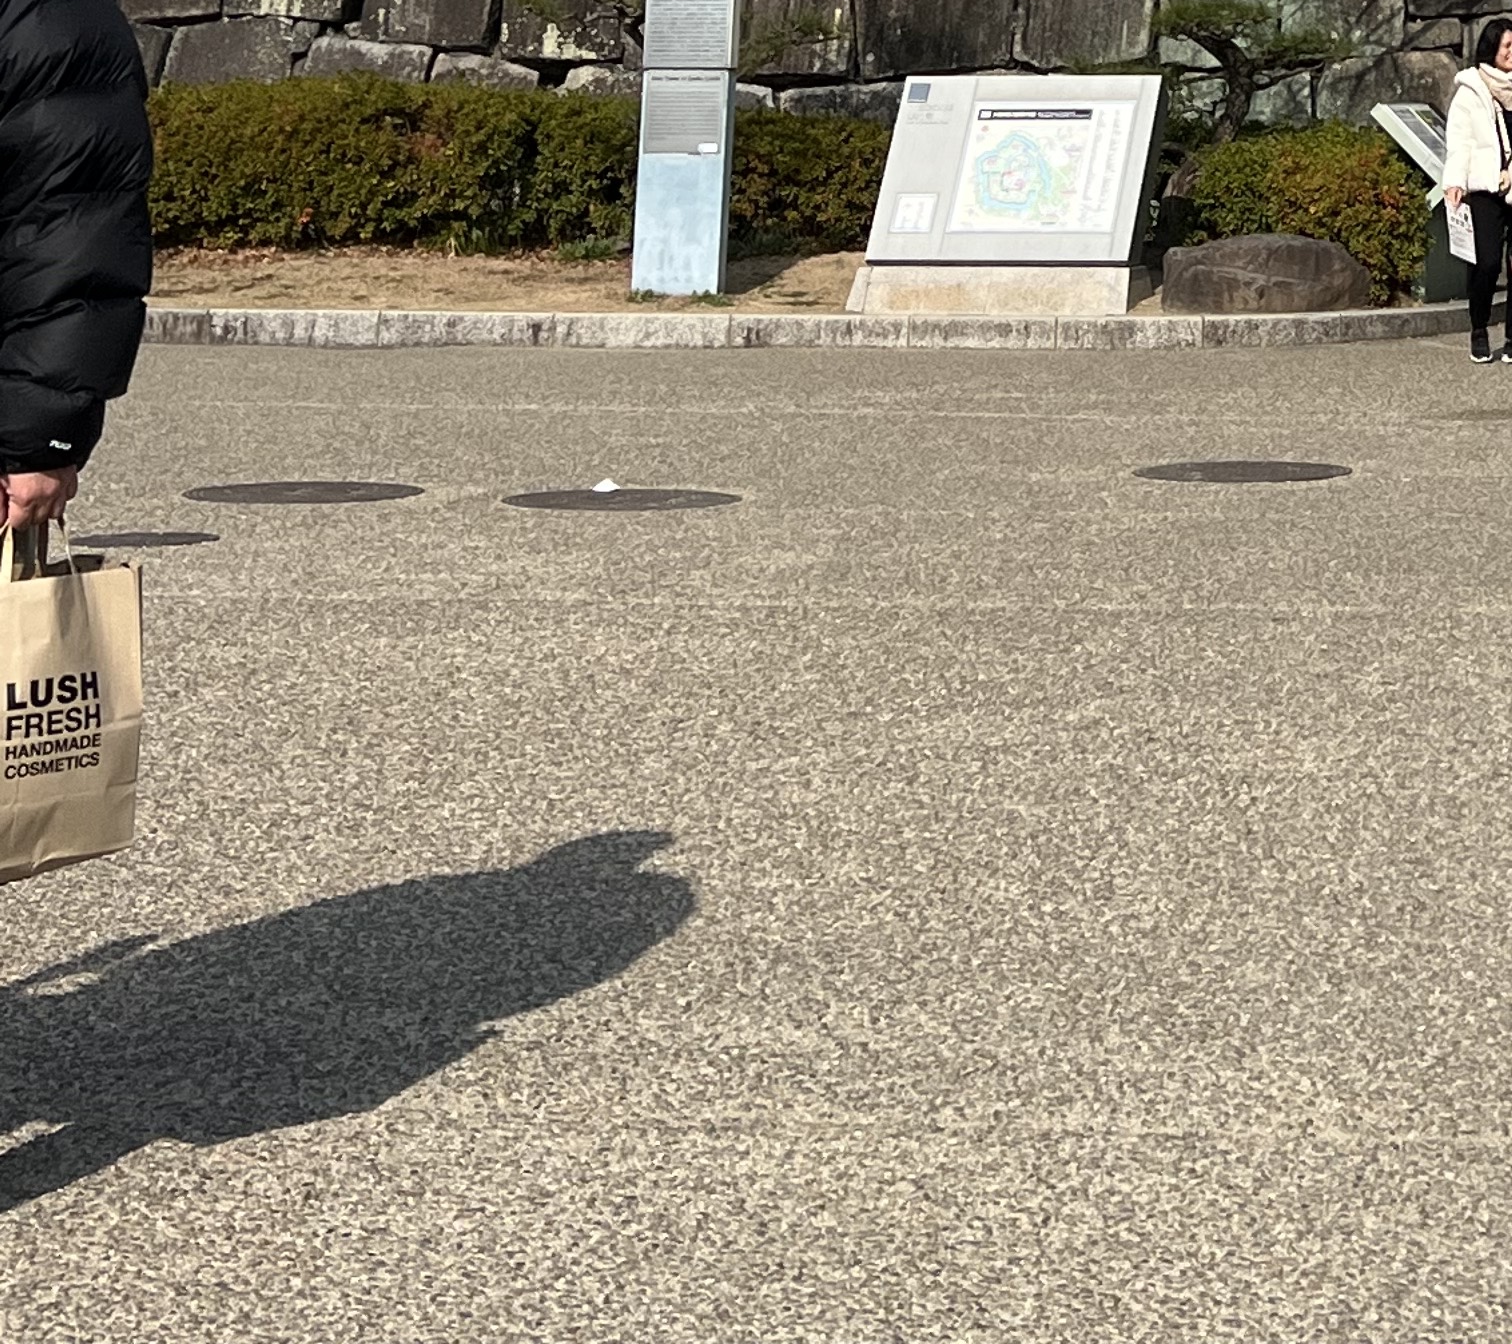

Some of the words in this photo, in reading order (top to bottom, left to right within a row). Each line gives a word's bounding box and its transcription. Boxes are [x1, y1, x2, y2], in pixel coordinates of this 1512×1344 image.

[6, 671, 99, 711] LUSH
[5, 703, 101, 741] FRESH
[5, 732, 102, 761] HANDMADE
[4, 752, 100, 780] COSMETICS
